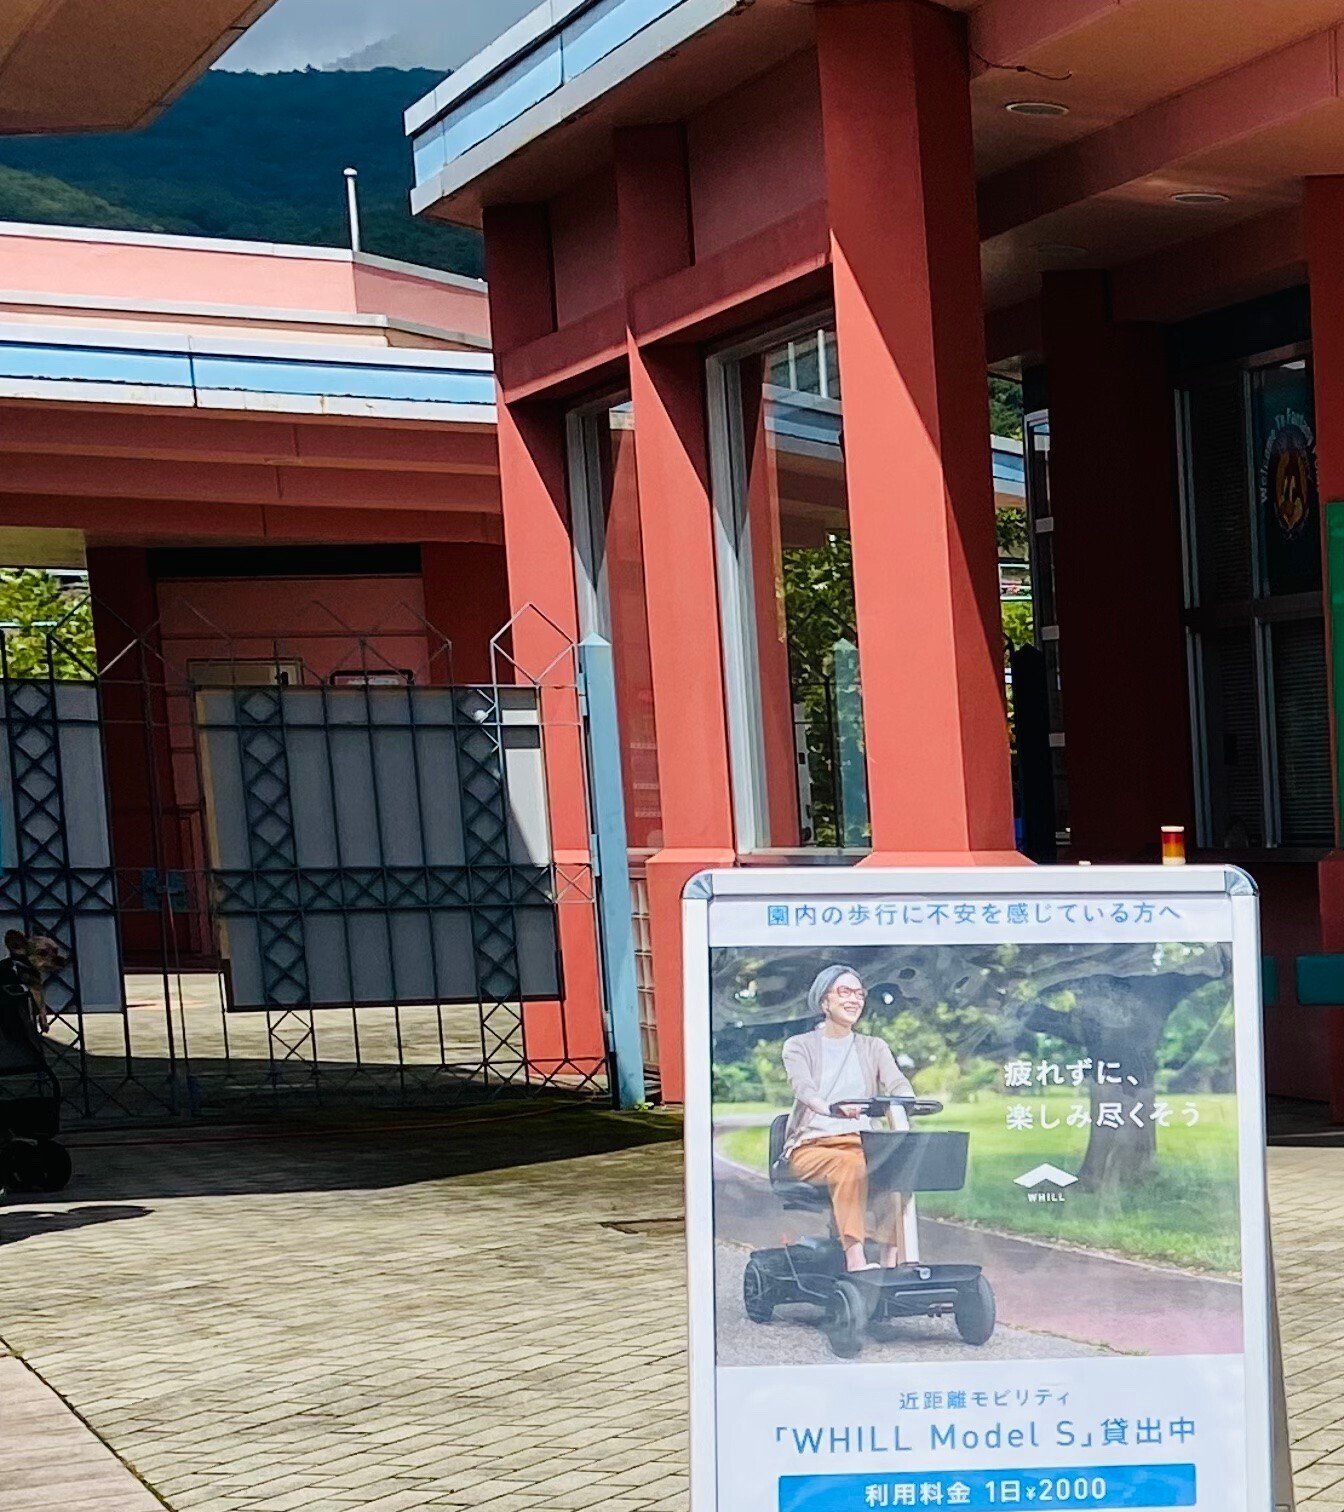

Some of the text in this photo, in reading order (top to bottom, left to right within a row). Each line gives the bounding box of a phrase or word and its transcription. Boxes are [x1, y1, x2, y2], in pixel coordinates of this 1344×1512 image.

[767, 902, 1182, 927] 園内の歩行に不安を感じている方へ
[1004, 1057, 1139, 1087] 疲れずに、
[1006, 1101, 1200, 1131] 楽しみ尽くそう
[1027, 1192, 1066, 1203] WHILL
[899, 1388, 1071, 1411] 近距離モビリティ
[930, 1421, 1039, 1450] Model
[865, 1480, 971, 1507] 利用料金
